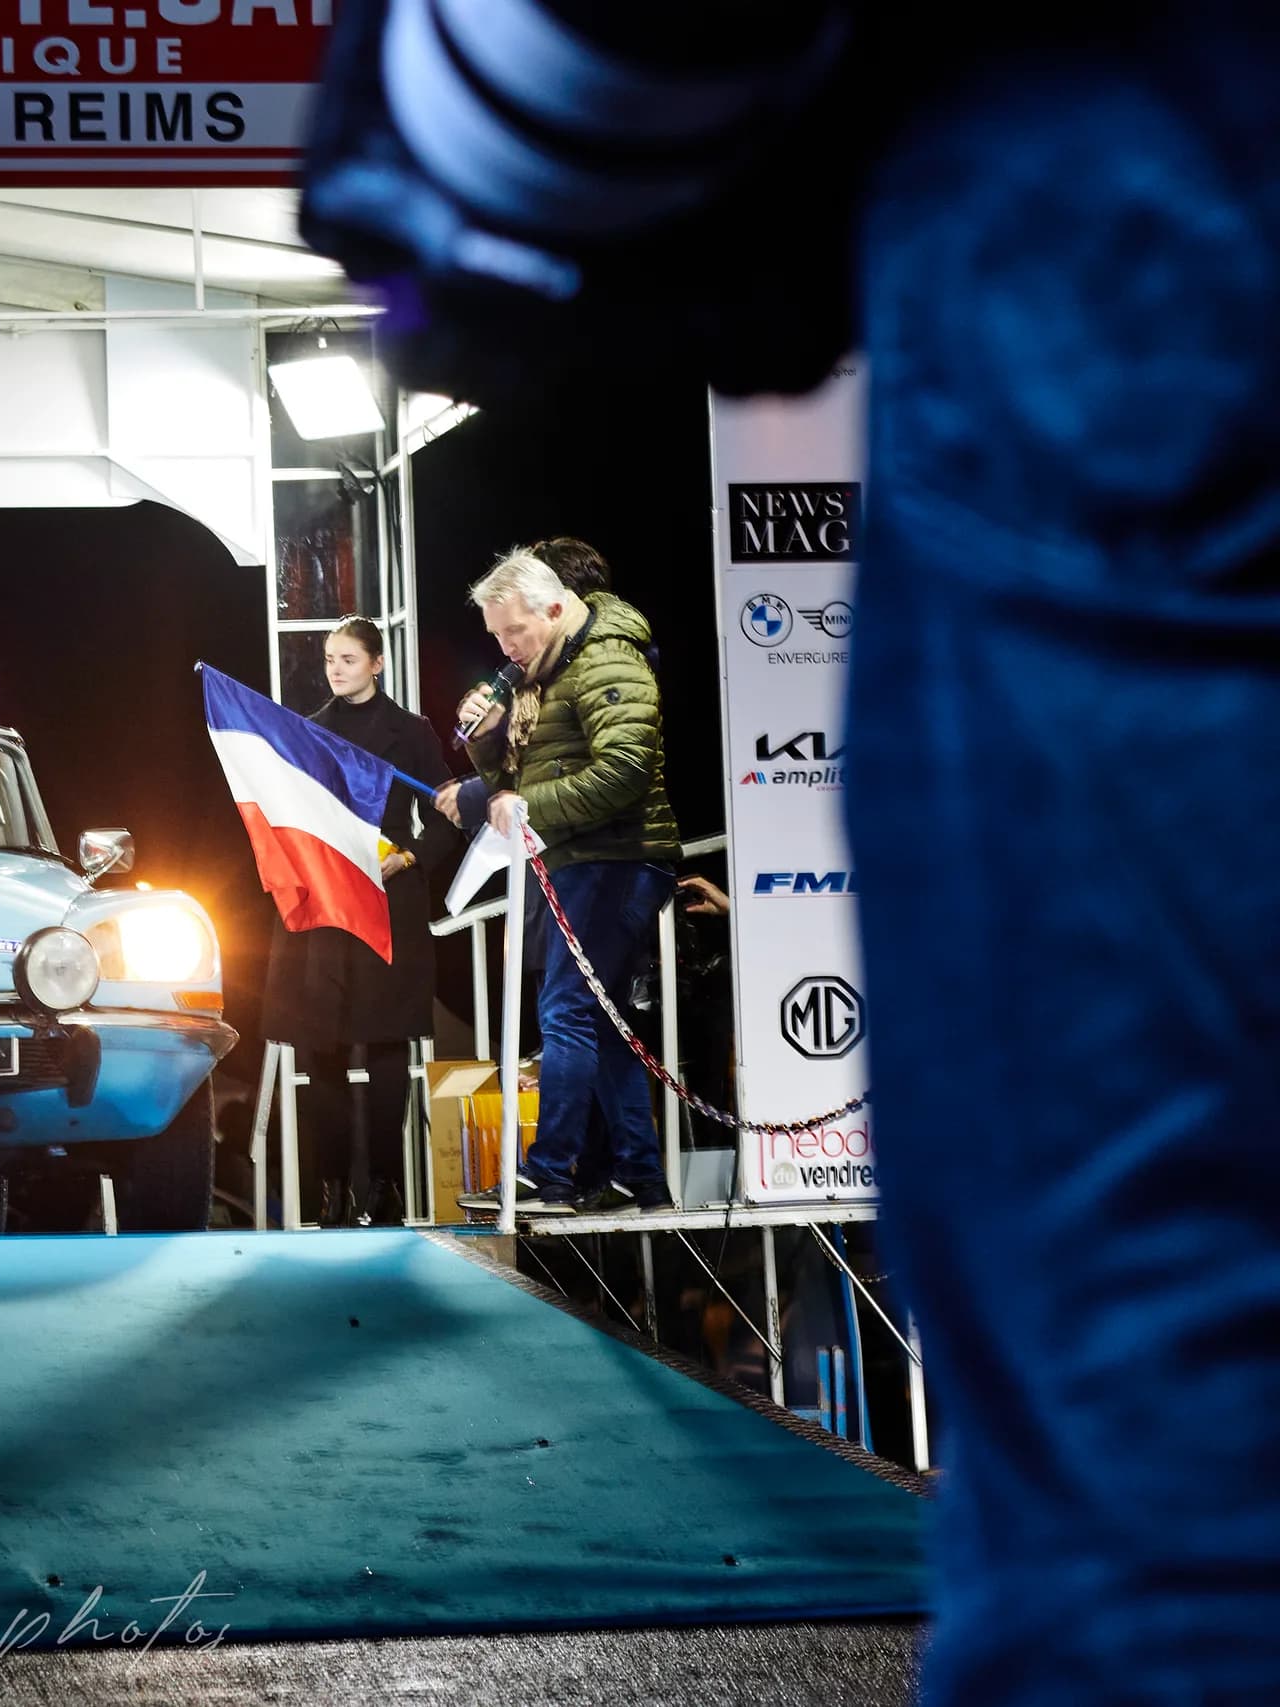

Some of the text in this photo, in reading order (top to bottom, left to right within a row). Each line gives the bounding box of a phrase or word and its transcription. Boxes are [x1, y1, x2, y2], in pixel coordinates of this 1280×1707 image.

[14, 91, 247, 142] REIMS
[740, 490, 844, 517] NEWS
[741, 519, 851, 554] MAG
[747, 595, 786, 613] BMW
[824, 614, 853, 626] MINI
[768, 651, 849, 665] ENVERGURE
[791, 986, 856, 1051] MG
[773, 1166, 796, 1186] du
